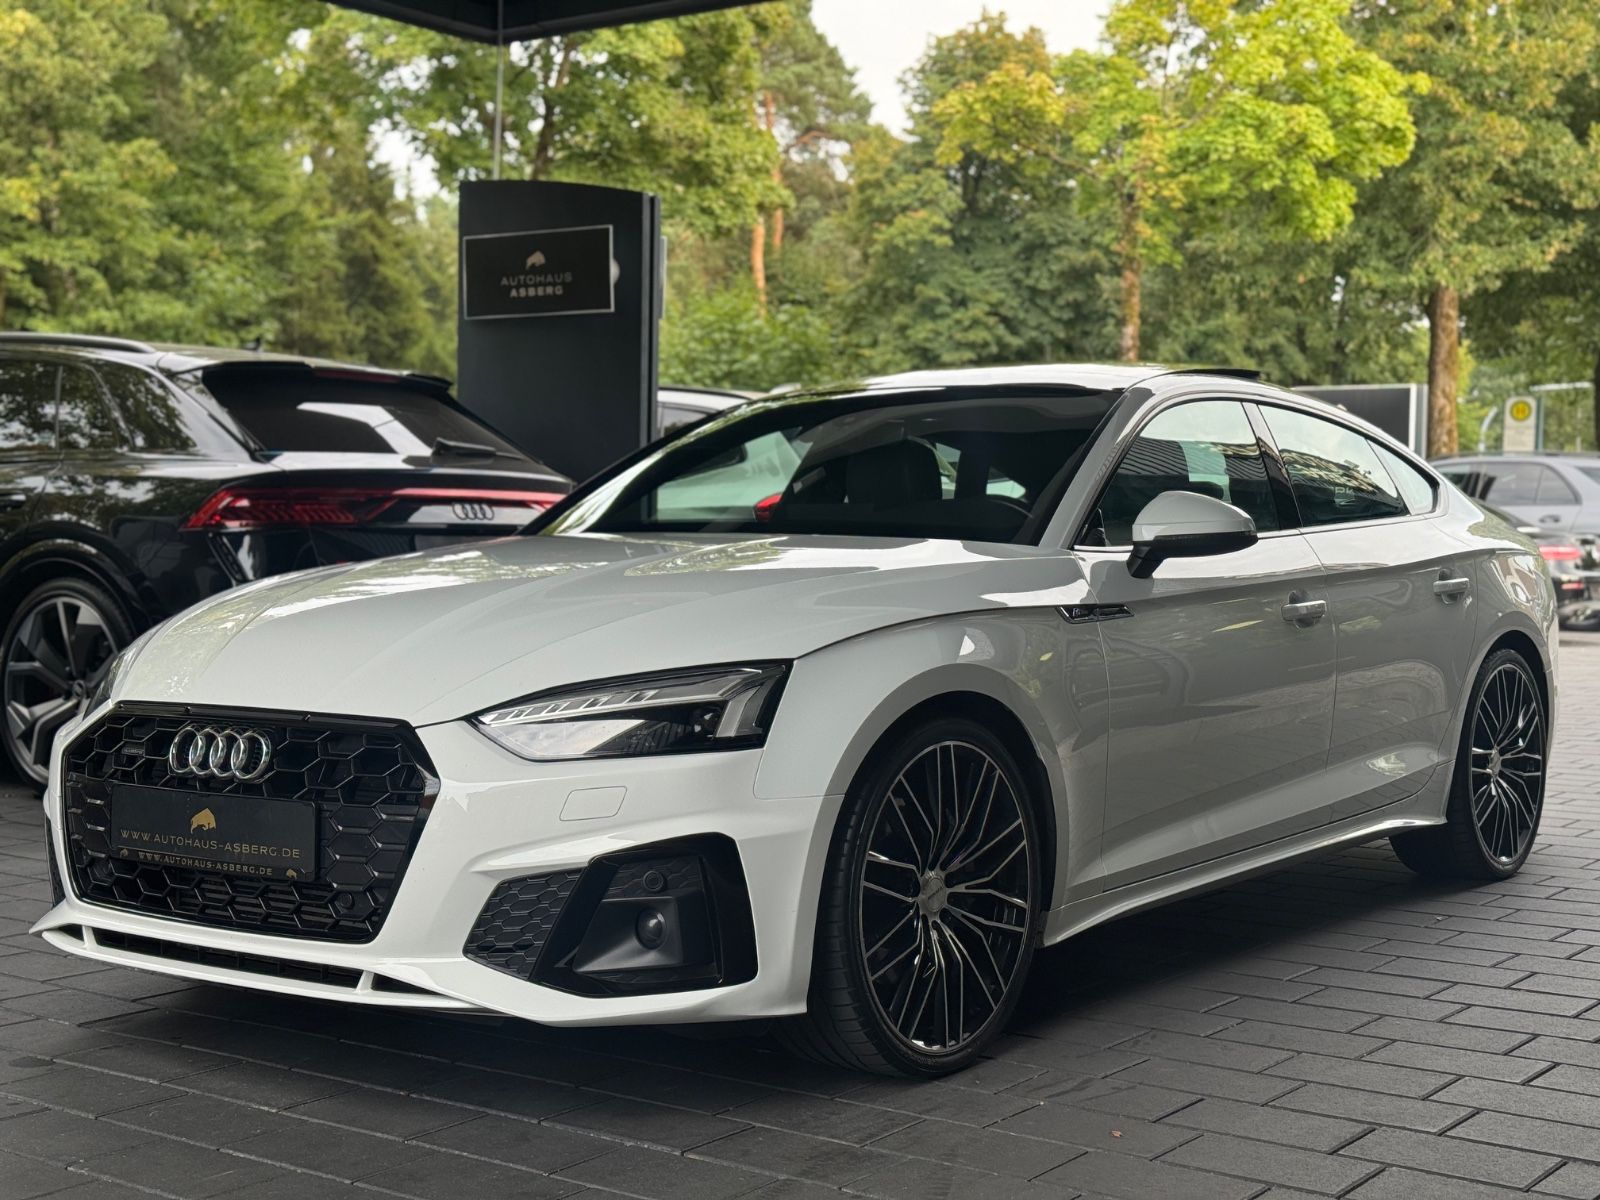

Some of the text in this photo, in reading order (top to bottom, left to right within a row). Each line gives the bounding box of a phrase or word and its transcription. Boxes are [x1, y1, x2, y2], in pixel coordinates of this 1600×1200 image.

[500, 272, 573, 286] AUTOHAUS
[510, 285, 564, 298] ASBERG
[120, 829, 301, 858] WWW.AUTOHAUS-ASBERG.DE
[138, 851, 273, 876] WWW.AUTOHAUS-ASBERG.DE
